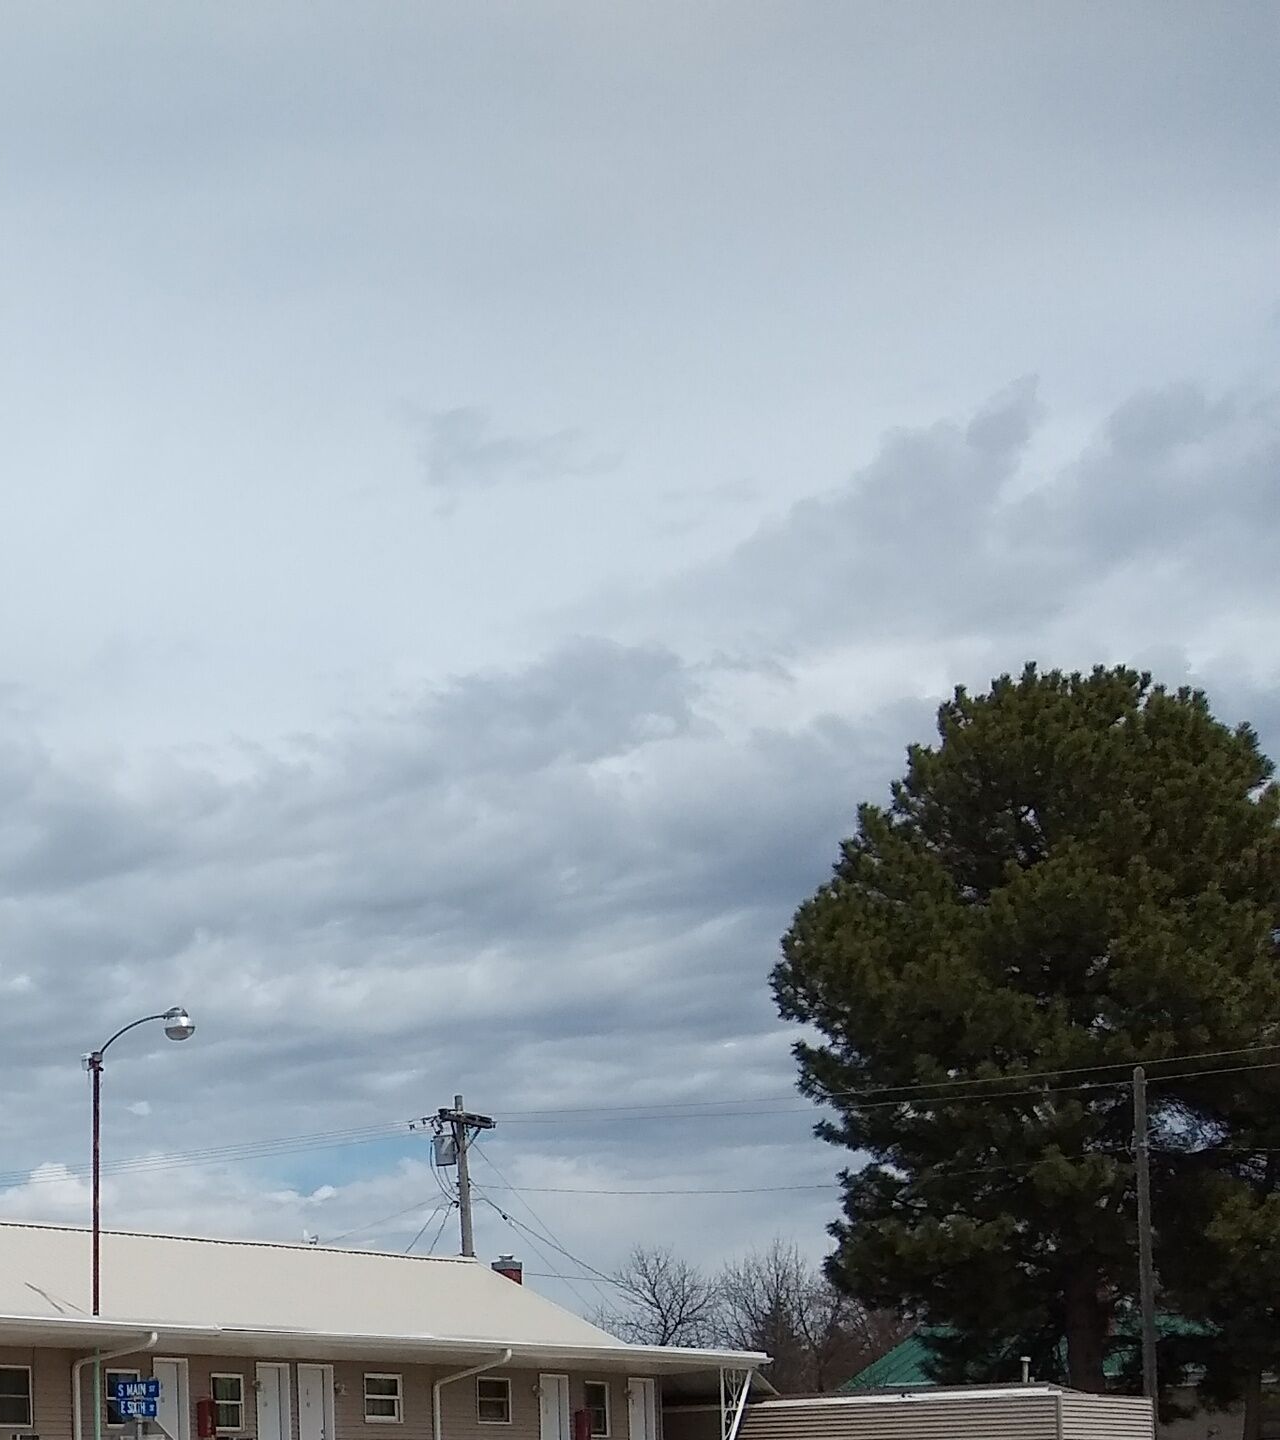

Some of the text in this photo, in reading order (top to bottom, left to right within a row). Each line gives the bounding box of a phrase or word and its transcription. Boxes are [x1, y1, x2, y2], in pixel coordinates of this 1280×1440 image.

[118, 1384, 124, 1396] S
[126, 1384, 146, 1396] MAIN
[120, 1401, 125, 1414] E
[127, 1401, 146, 1414] SIXTH
